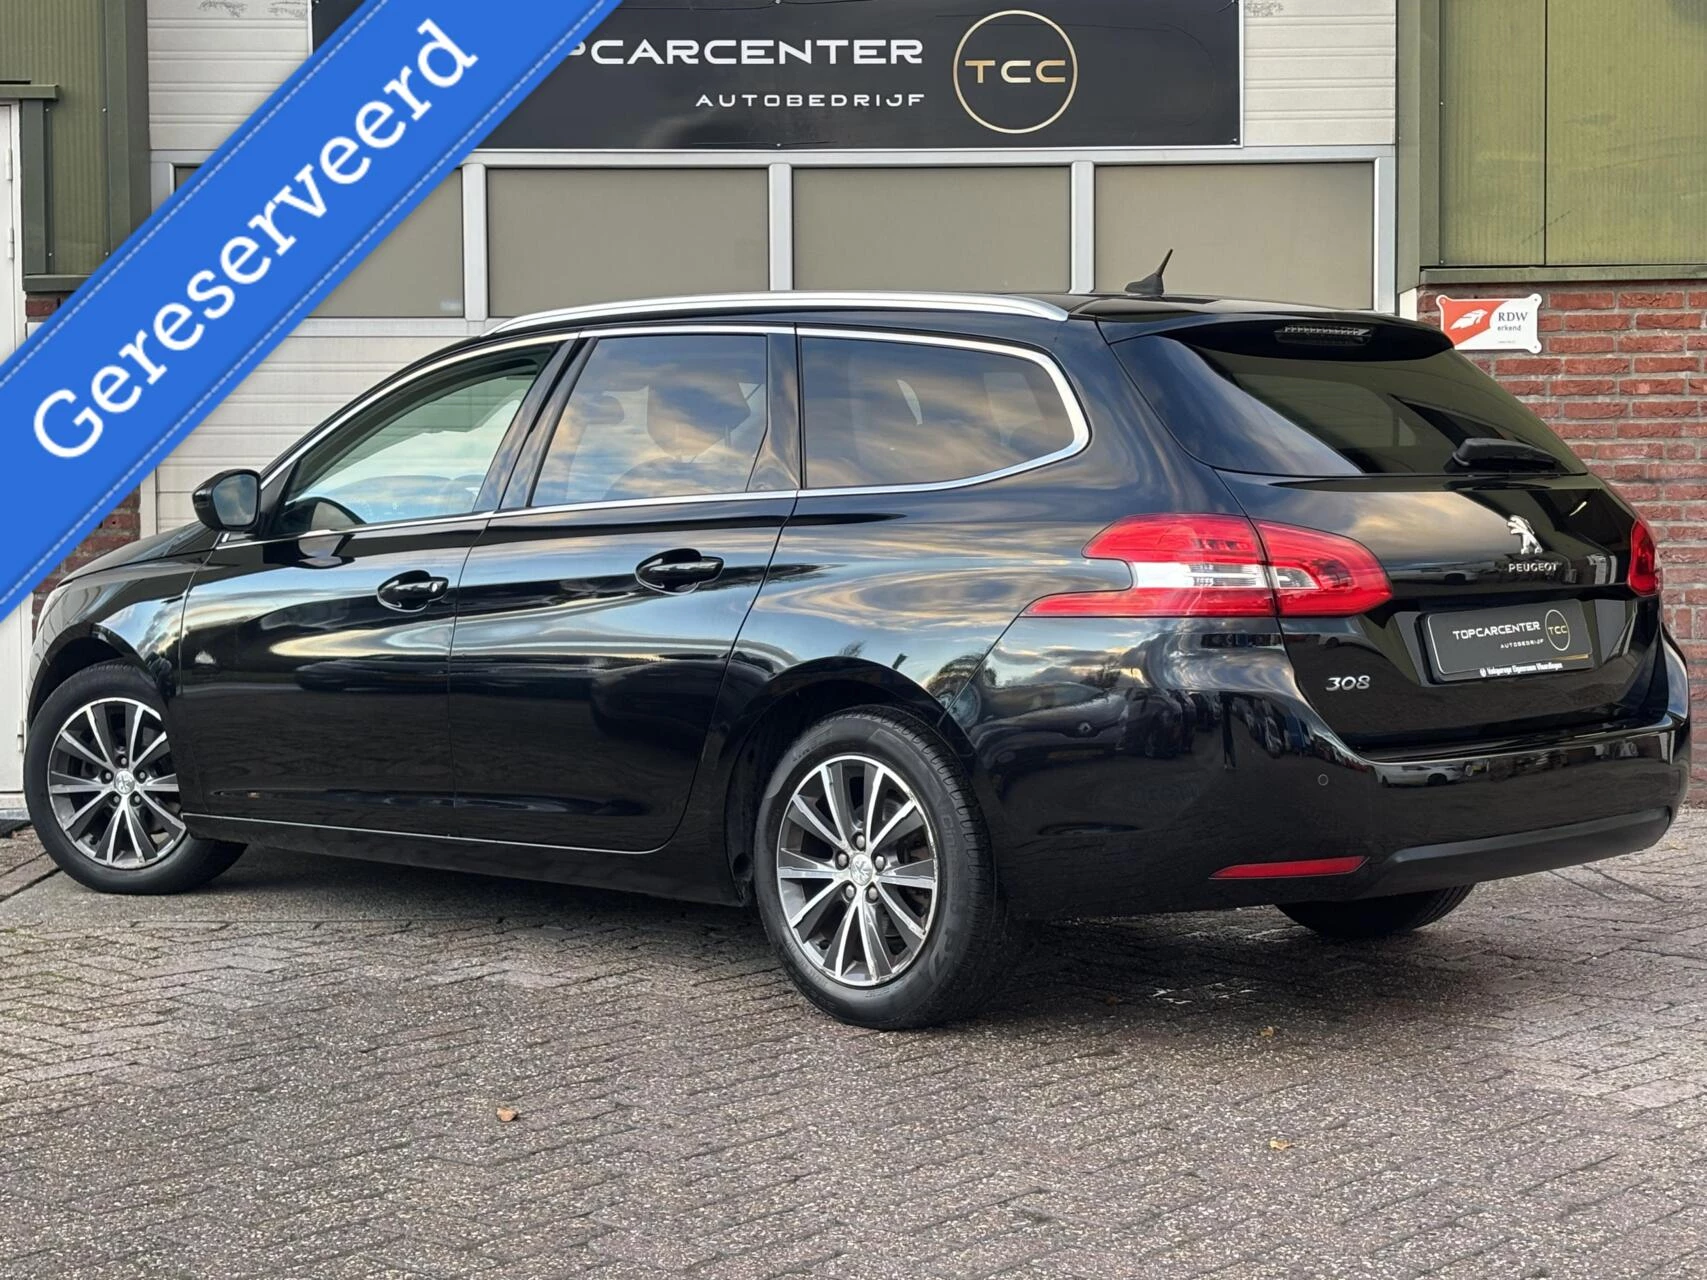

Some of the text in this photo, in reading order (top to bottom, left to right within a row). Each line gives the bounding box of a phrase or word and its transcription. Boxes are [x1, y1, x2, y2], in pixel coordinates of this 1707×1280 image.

[965, 60, 1066, 84] TCC
[695, 94, 925, 107] AUTOBEDRIJF
[1498, 311, 1528, 322] RDW
[1508, 562, 1557, 573] PEUGEOT
[1452, 621, 1541, 640] TOPCARCENTER
[1548, 625, 1569, 635] TCC
[1325, 675, 1371, 691] 308
